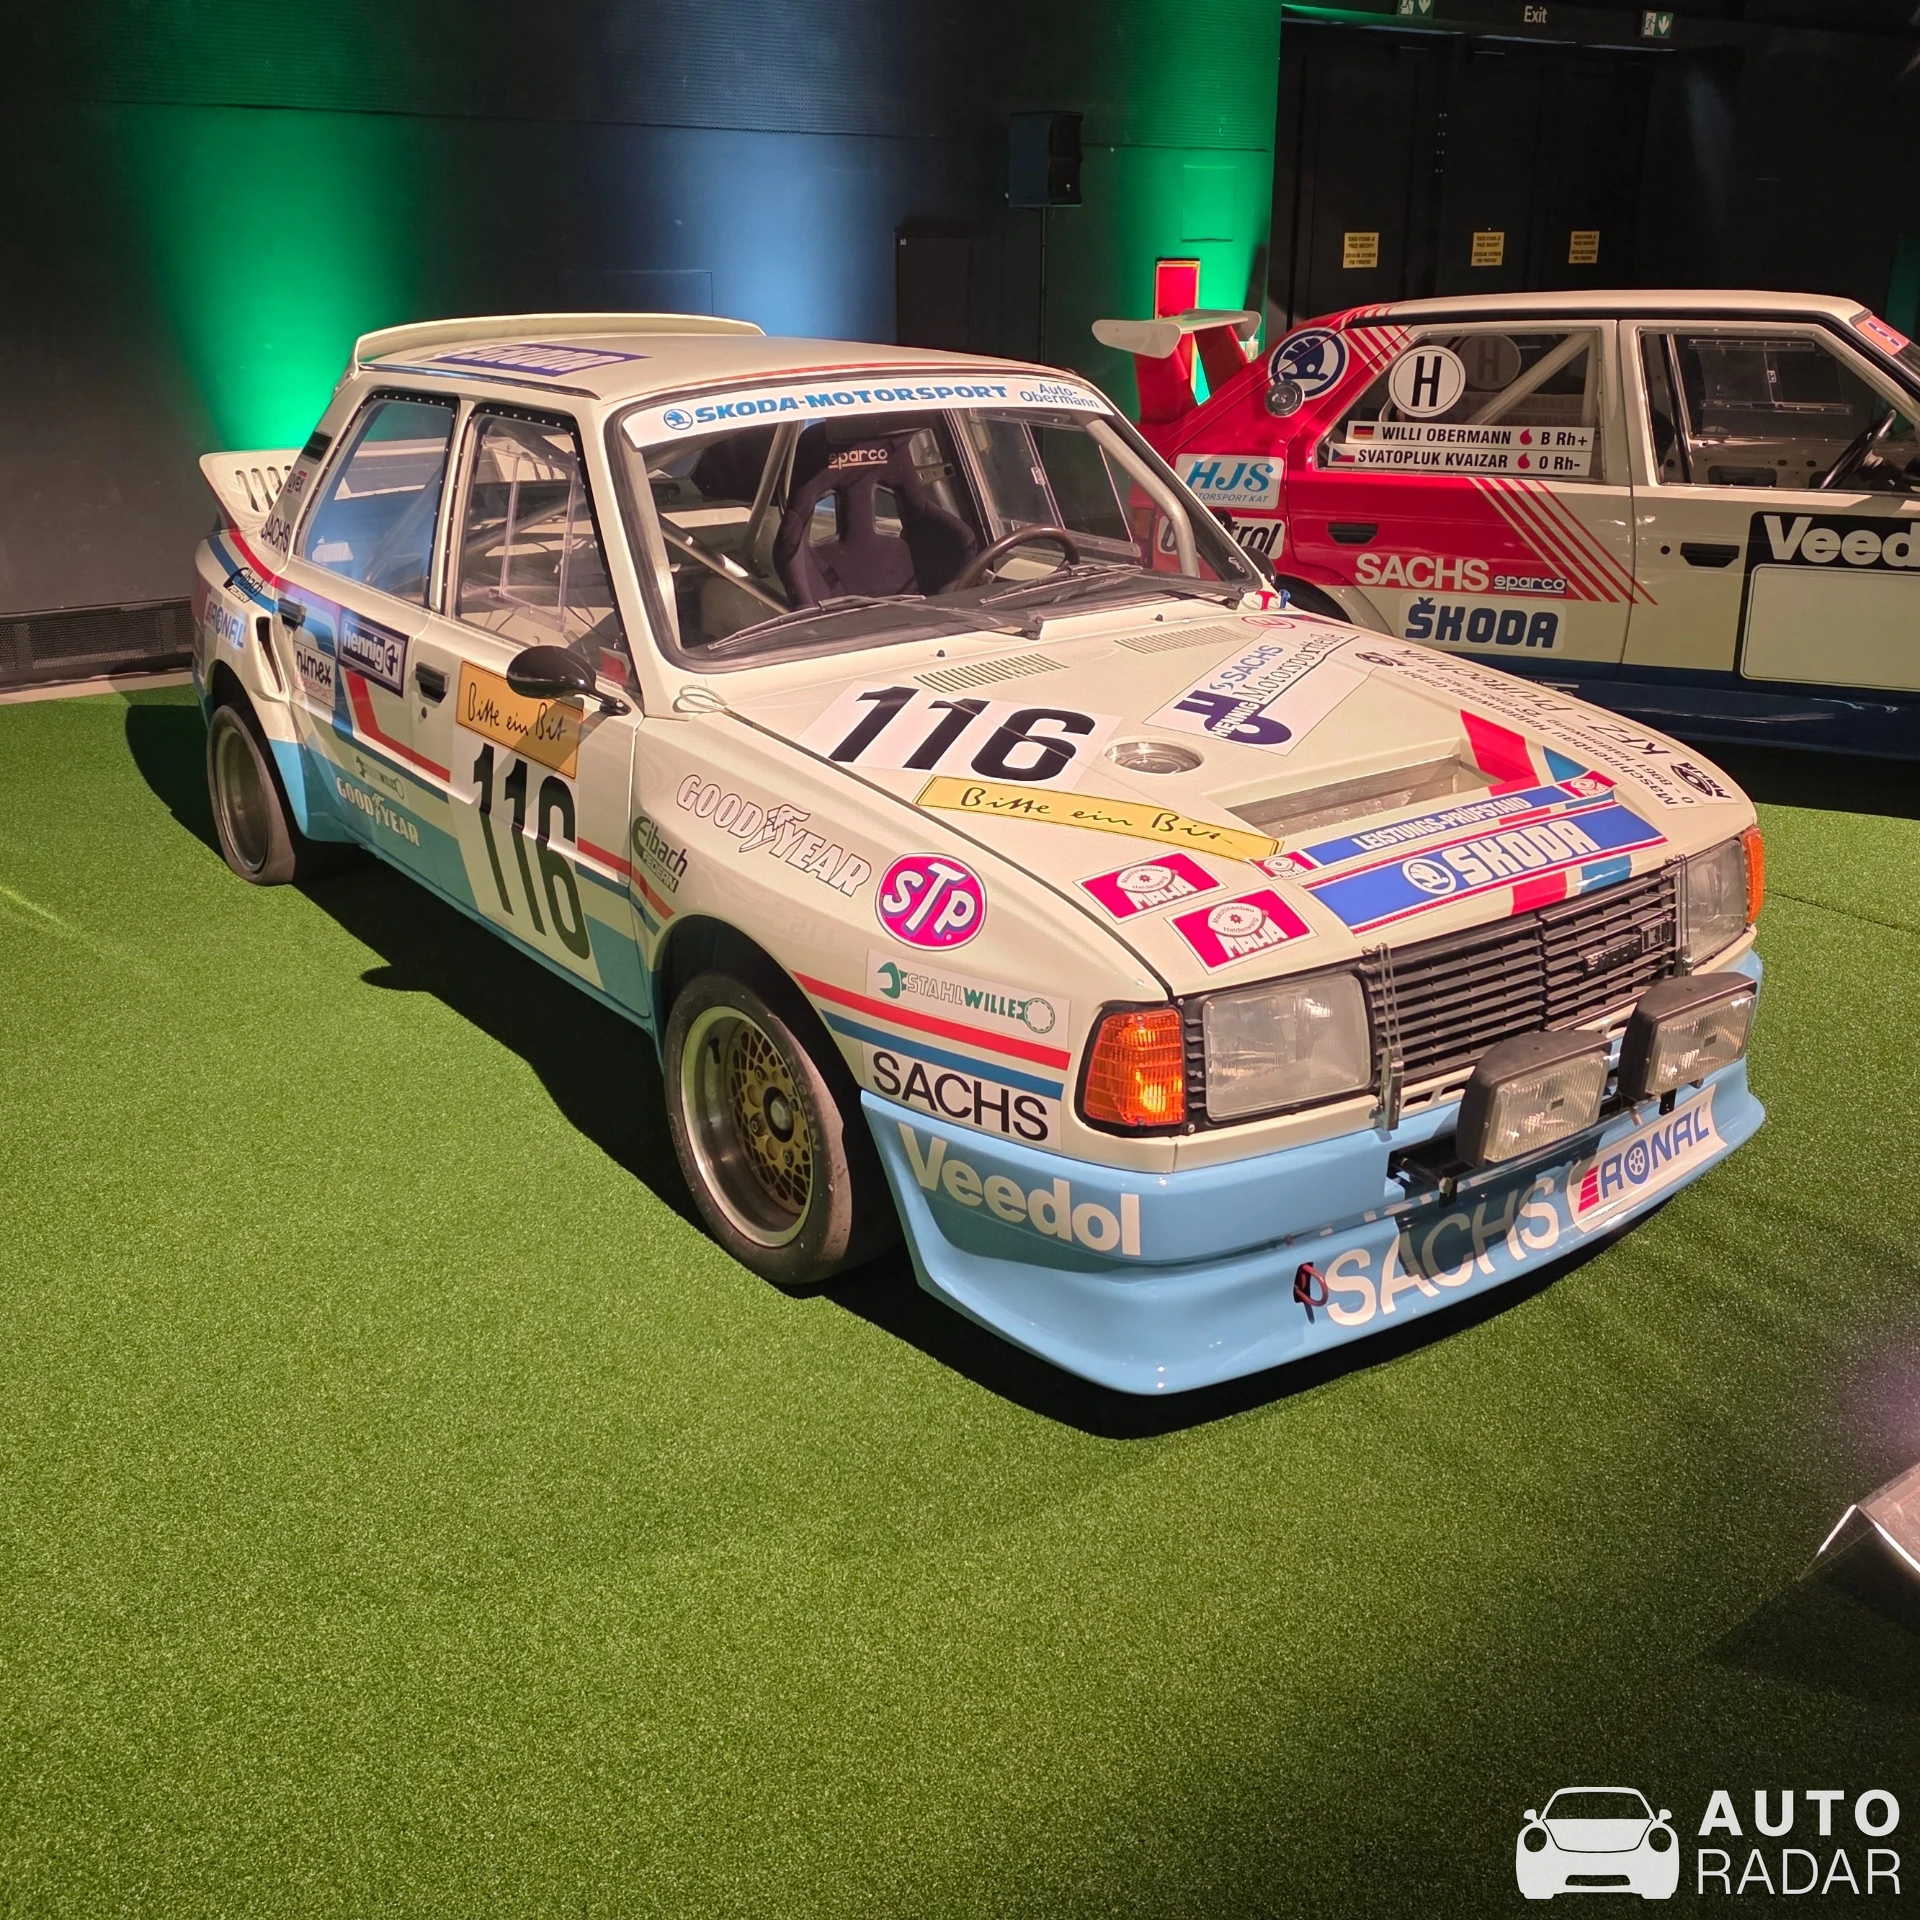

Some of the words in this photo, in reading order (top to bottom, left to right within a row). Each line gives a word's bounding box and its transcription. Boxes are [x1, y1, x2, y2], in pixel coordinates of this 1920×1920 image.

[1524, 5, 1548, 24] Exit
[695, 385, 1007, 424] SKODA-MOTORSPORT
[1020, 391, 1099, 409] Obermann
[1039, 383, 1077, 397] Auto-
[1411, 356, 1442, 407] H
[1382, 426, 1422, 442] WILLI
[1427, 428, 1512, 445] OBERMANN
[1540, 431, 1551, 446] B
[1556, 432, 1589, 447] Rh+
[1185, 461, 1273, 492] HJS
[1358, 449, 1440, 466] SVATOPLUK
[1445, 452, 1509, 469] KVAIZAR
[1554, 456, 1581, 471] Rh-
[1197, 492, 1249, 504] TORSPORT
[1249, 494, 1269, 504] KAT
[1763, 514, 1920, 567] Veed
[1355, 552, 1489, 591] SACHS
[1494, 574, 1566, 593] sparco
[209, 603, 244, 649] RONAL
[1405, 596, 1559, 649] ŠKODA
[343, 622, 385, 672] hennig
[1220, 644, 1284, 682] SACHS
[467, 682, 500, 729] Bitte
[505, 714, 529, 737] ein
[535, 702, 568, 742] Bit
[827, 685, 1096, 782] 116
[1210, 701, 1260, 738] HENNIG
[1586, 723, 1672, 755] KFZ
[1551, 731, 1679, 806] Maschinenbau
[1635, 764, 1673, 786] 8961
[1676, 762, 1733, 800] MAHA
[336, 776, 421, 848] GOODYEAR
[960, 786, 1052, 815] Bitte
[1070, 809, 1133, 827] ein
[1351, 796, 1534, 851] LEISTUNGS-PRÜFSTAND
[473, 742, 591, 960] 116
[632, 815, 689, 878] Eibach
[677, 774, 872, 898] GOODYEAR
[1441, 819, 1602, 887] SKODA
[881, 861, 978, 937] STP
[1124, 881, 1200, 912] MAHA
[1211, 905, 1256, 925] Maschinenbau
[1215, 918, 1292, 960] MAHA
[906, 972, 1018, 1019] STAHLWILLE
[872, 1051, 1049, 1142] SACHS
[1600, 1105, 1710, 1200] RONAL
[898, 1122, 1141, 1256] Veedol
[1324, 1176, 1560, 1326] SACHS
